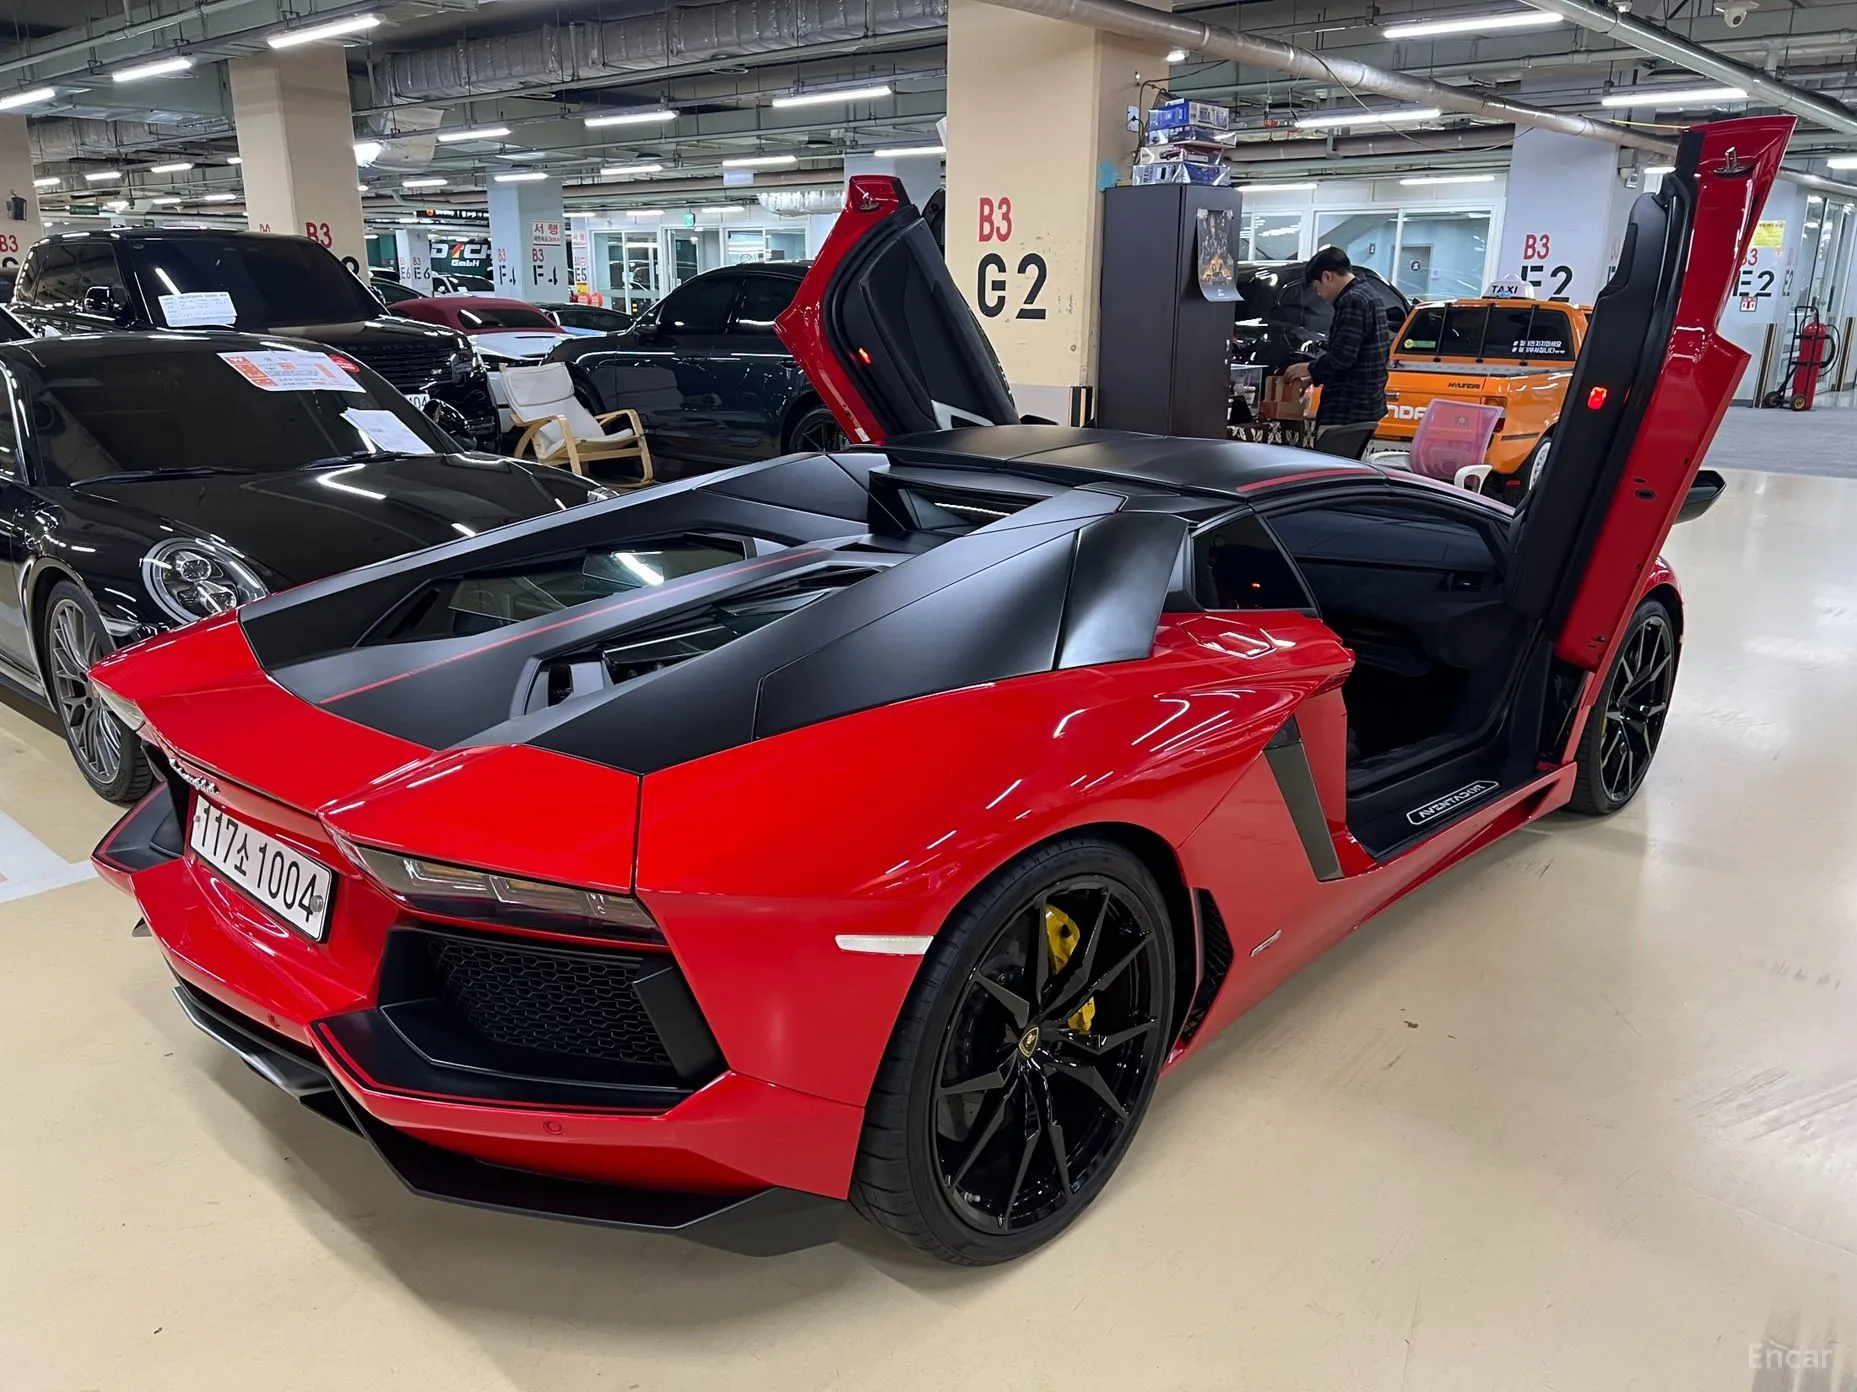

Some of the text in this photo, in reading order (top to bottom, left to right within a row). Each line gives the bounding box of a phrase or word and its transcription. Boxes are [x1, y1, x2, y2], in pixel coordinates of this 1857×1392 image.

[978, 196, 1014, 242] B3
[0, 234, 19, 252] B3
[306, 222, 333, 249] B3
[498, 248, 507, 262] B3
[532, 248, 545, 263] B3
[1523, 234, 1550, 260] B3
[451, 259, 480, 267] GmbH
[1742, 248, 1758, 266] 3
[401, 267, 411, 279] E6
[414, 267, 431, 279] E6
[533, 264, 558, 286] F4
[575, 267, 587, 282] E5
[977, 252, 1048, 320] G2
[1492, 285, 1518, 294] TAXI
[1732, 269, 1775, 298] E2
[1419, 784, 1486, 818] AVENTADOR
[202, 803, 318, 923] 117소1004
